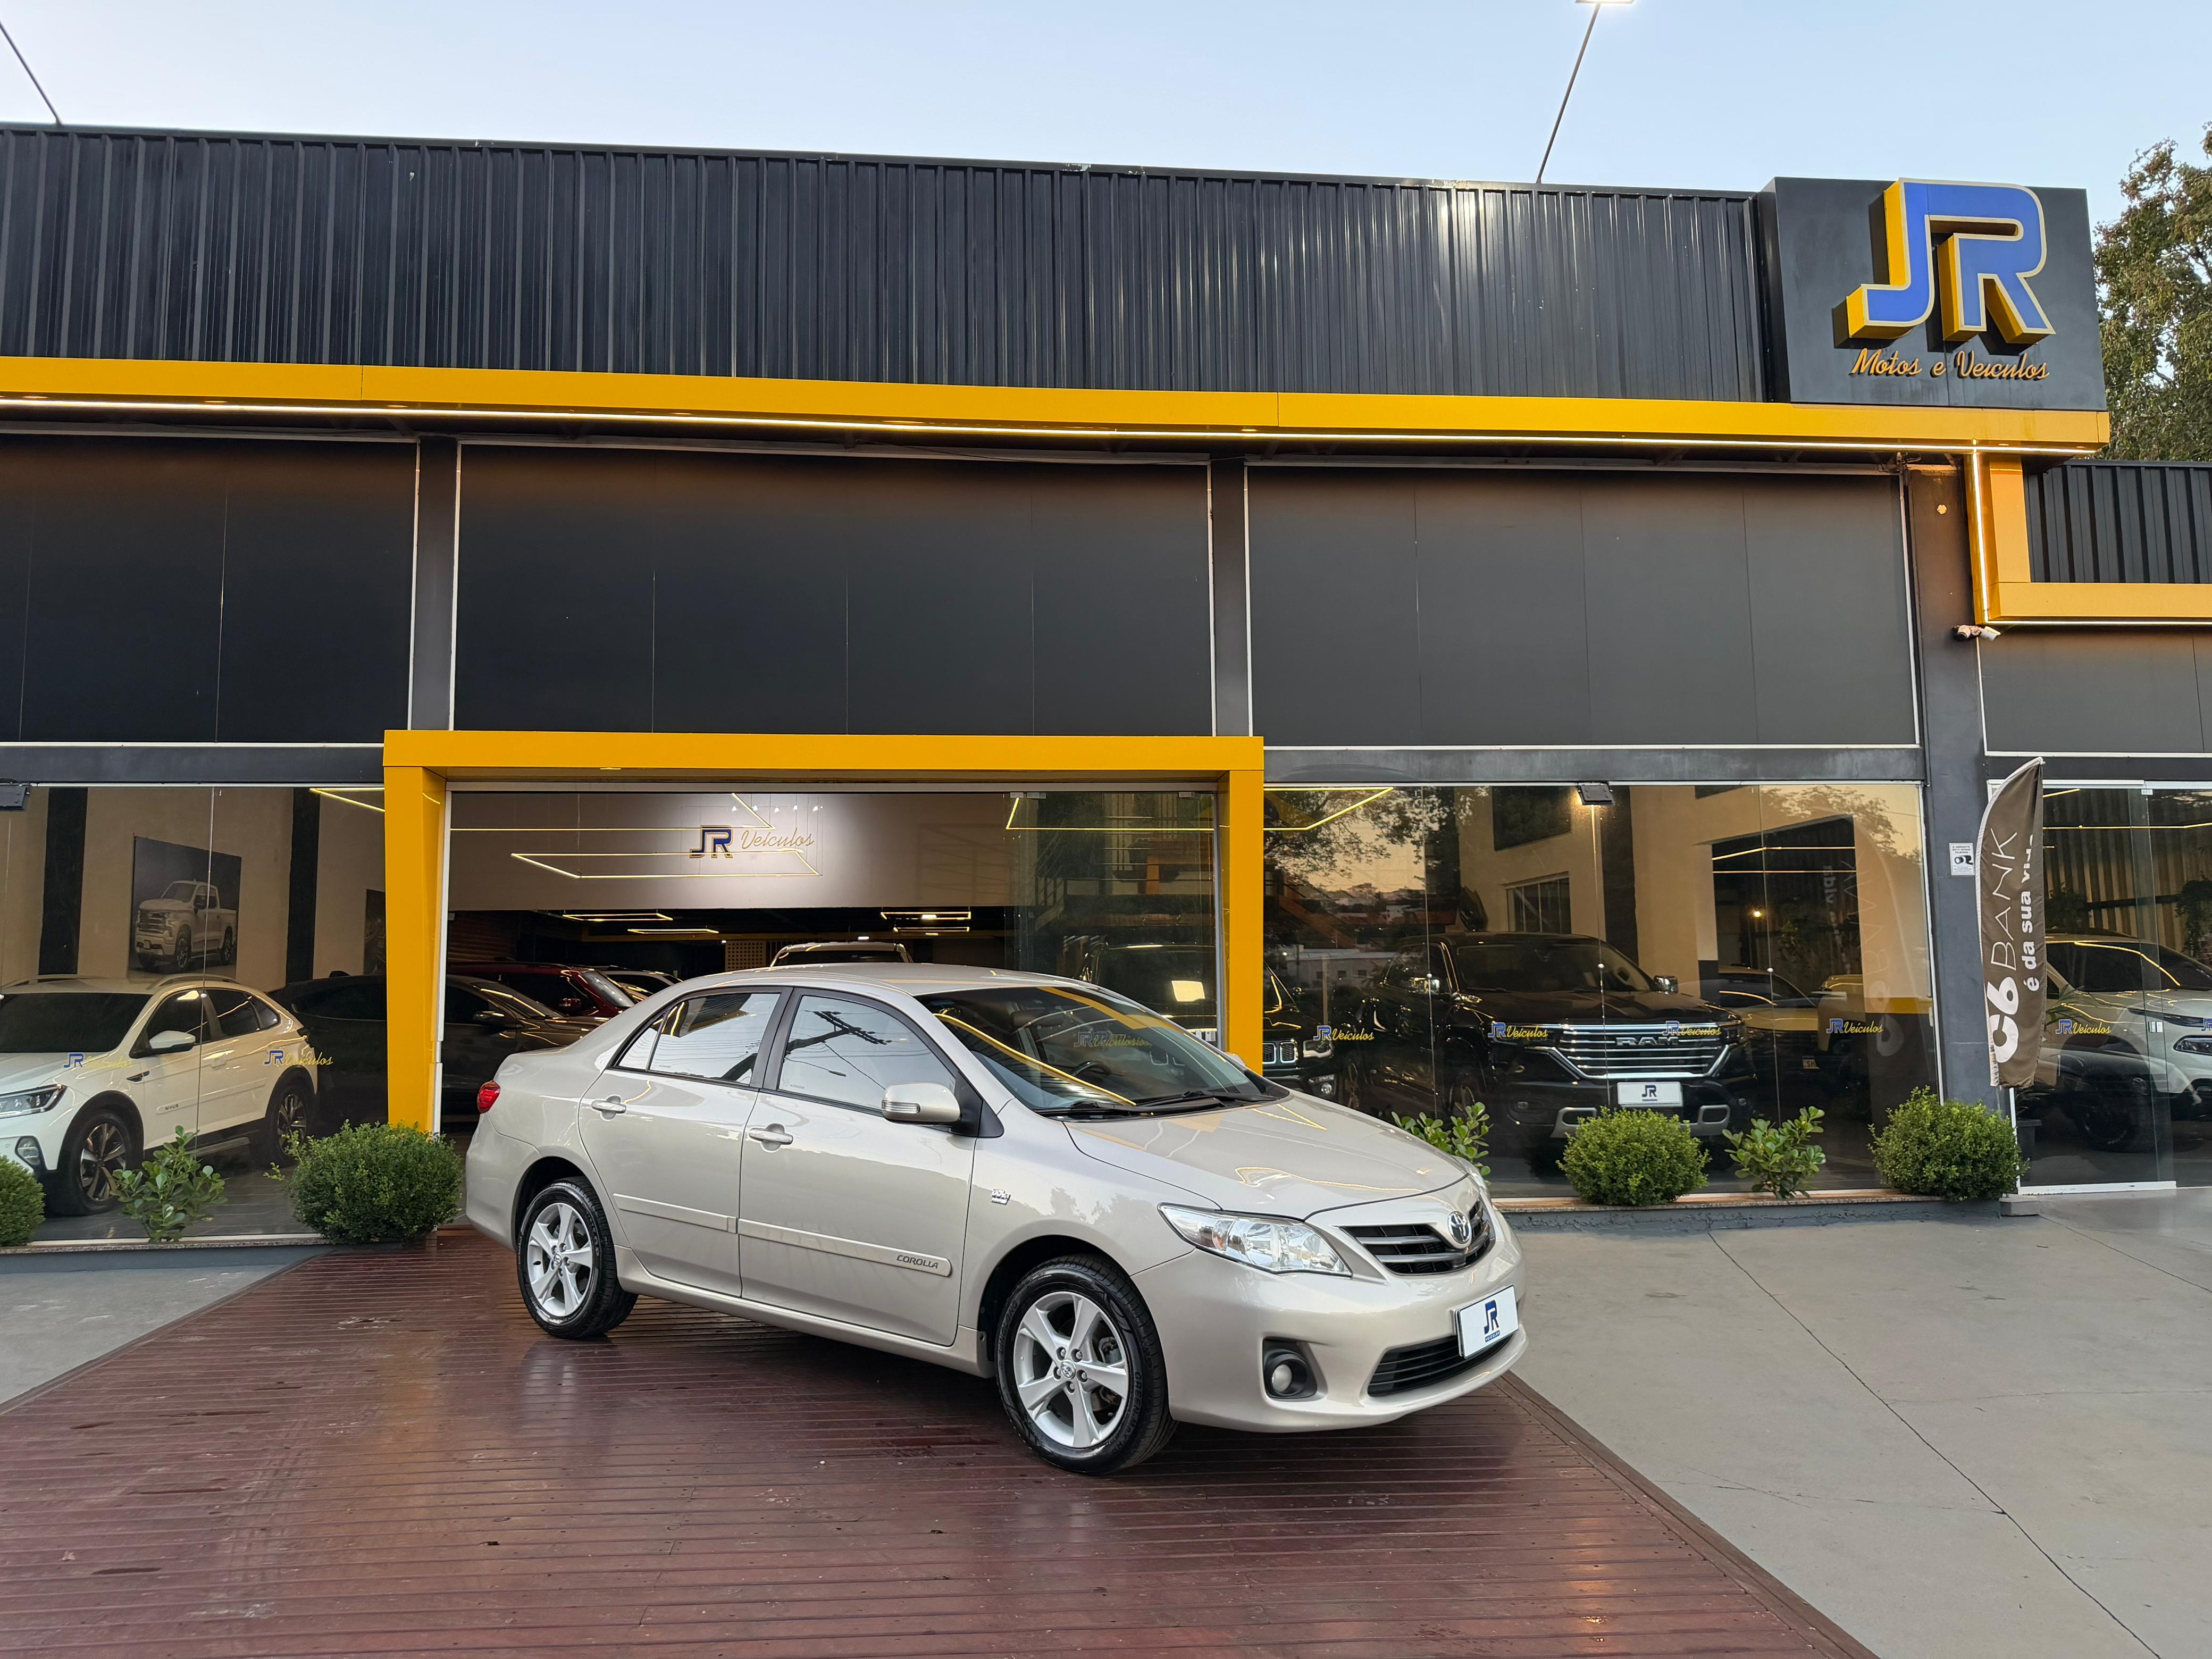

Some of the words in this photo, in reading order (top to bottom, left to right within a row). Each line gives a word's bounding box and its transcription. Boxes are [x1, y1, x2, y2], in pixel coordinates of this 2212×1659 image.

[1847, 178, 2056, 343] JR
[1850, 348, 1923, 376] Motos
[1932, 361, 1947, 376] e
[690, 825, 733, 859] JR
[1991, 827, 2017, 971] BANK
[2021, 891, 2033, 934] sua
[2021, 941, 2036, 970] da
[1826, 1018, 1844, 1034] JR
[1987, 976, 2019, 1063] C6
[2055, 1019, 2073, 1034] JR
[1313, 1025, 1332, 1041] JR
[1488, 1022, 1506, 1038] JR
[1662, 1020, 1681, 1036] JR
[1616, 1036, 1679, 1046] RAM
[63, 1052, 84, 1068] JR
[264, 1050, 284, 1066] JR
[1642, 1085, 1657, 1097] JR
[896, 1254, 939, 1269] COROLLA
[1484, 1300, 1499, 1335] JR
